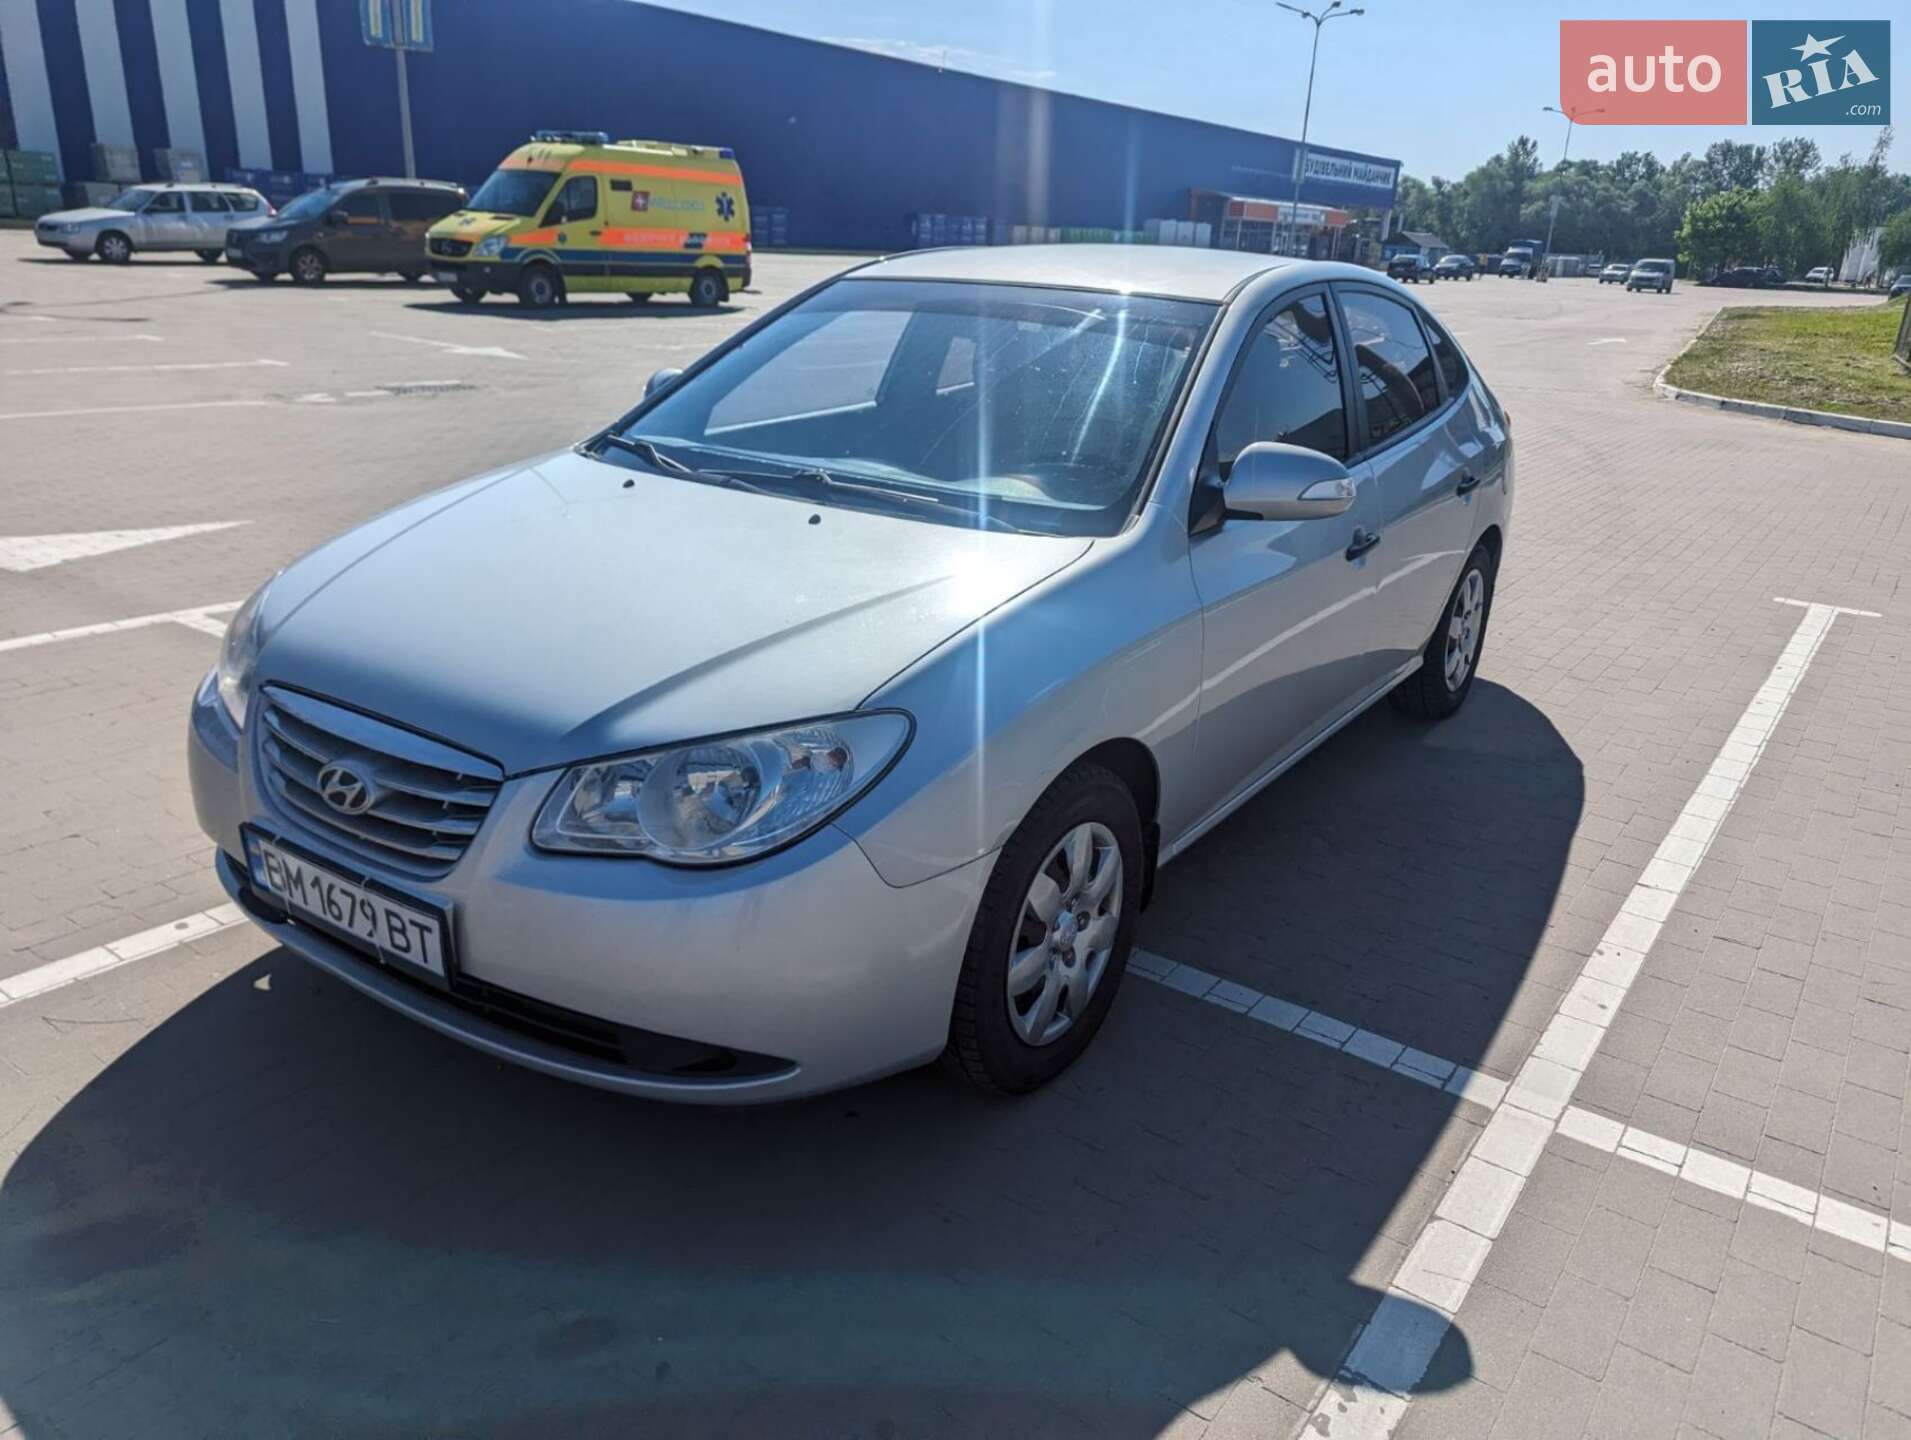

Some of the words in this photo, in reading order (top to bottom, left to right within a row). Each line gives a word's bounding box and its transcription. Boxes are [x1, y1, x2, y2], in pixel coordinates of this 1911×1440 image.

[263, 849, 308, 907] BM
[310, 875, 377, 939] 1679
[384, 908, 432, 964] BT
